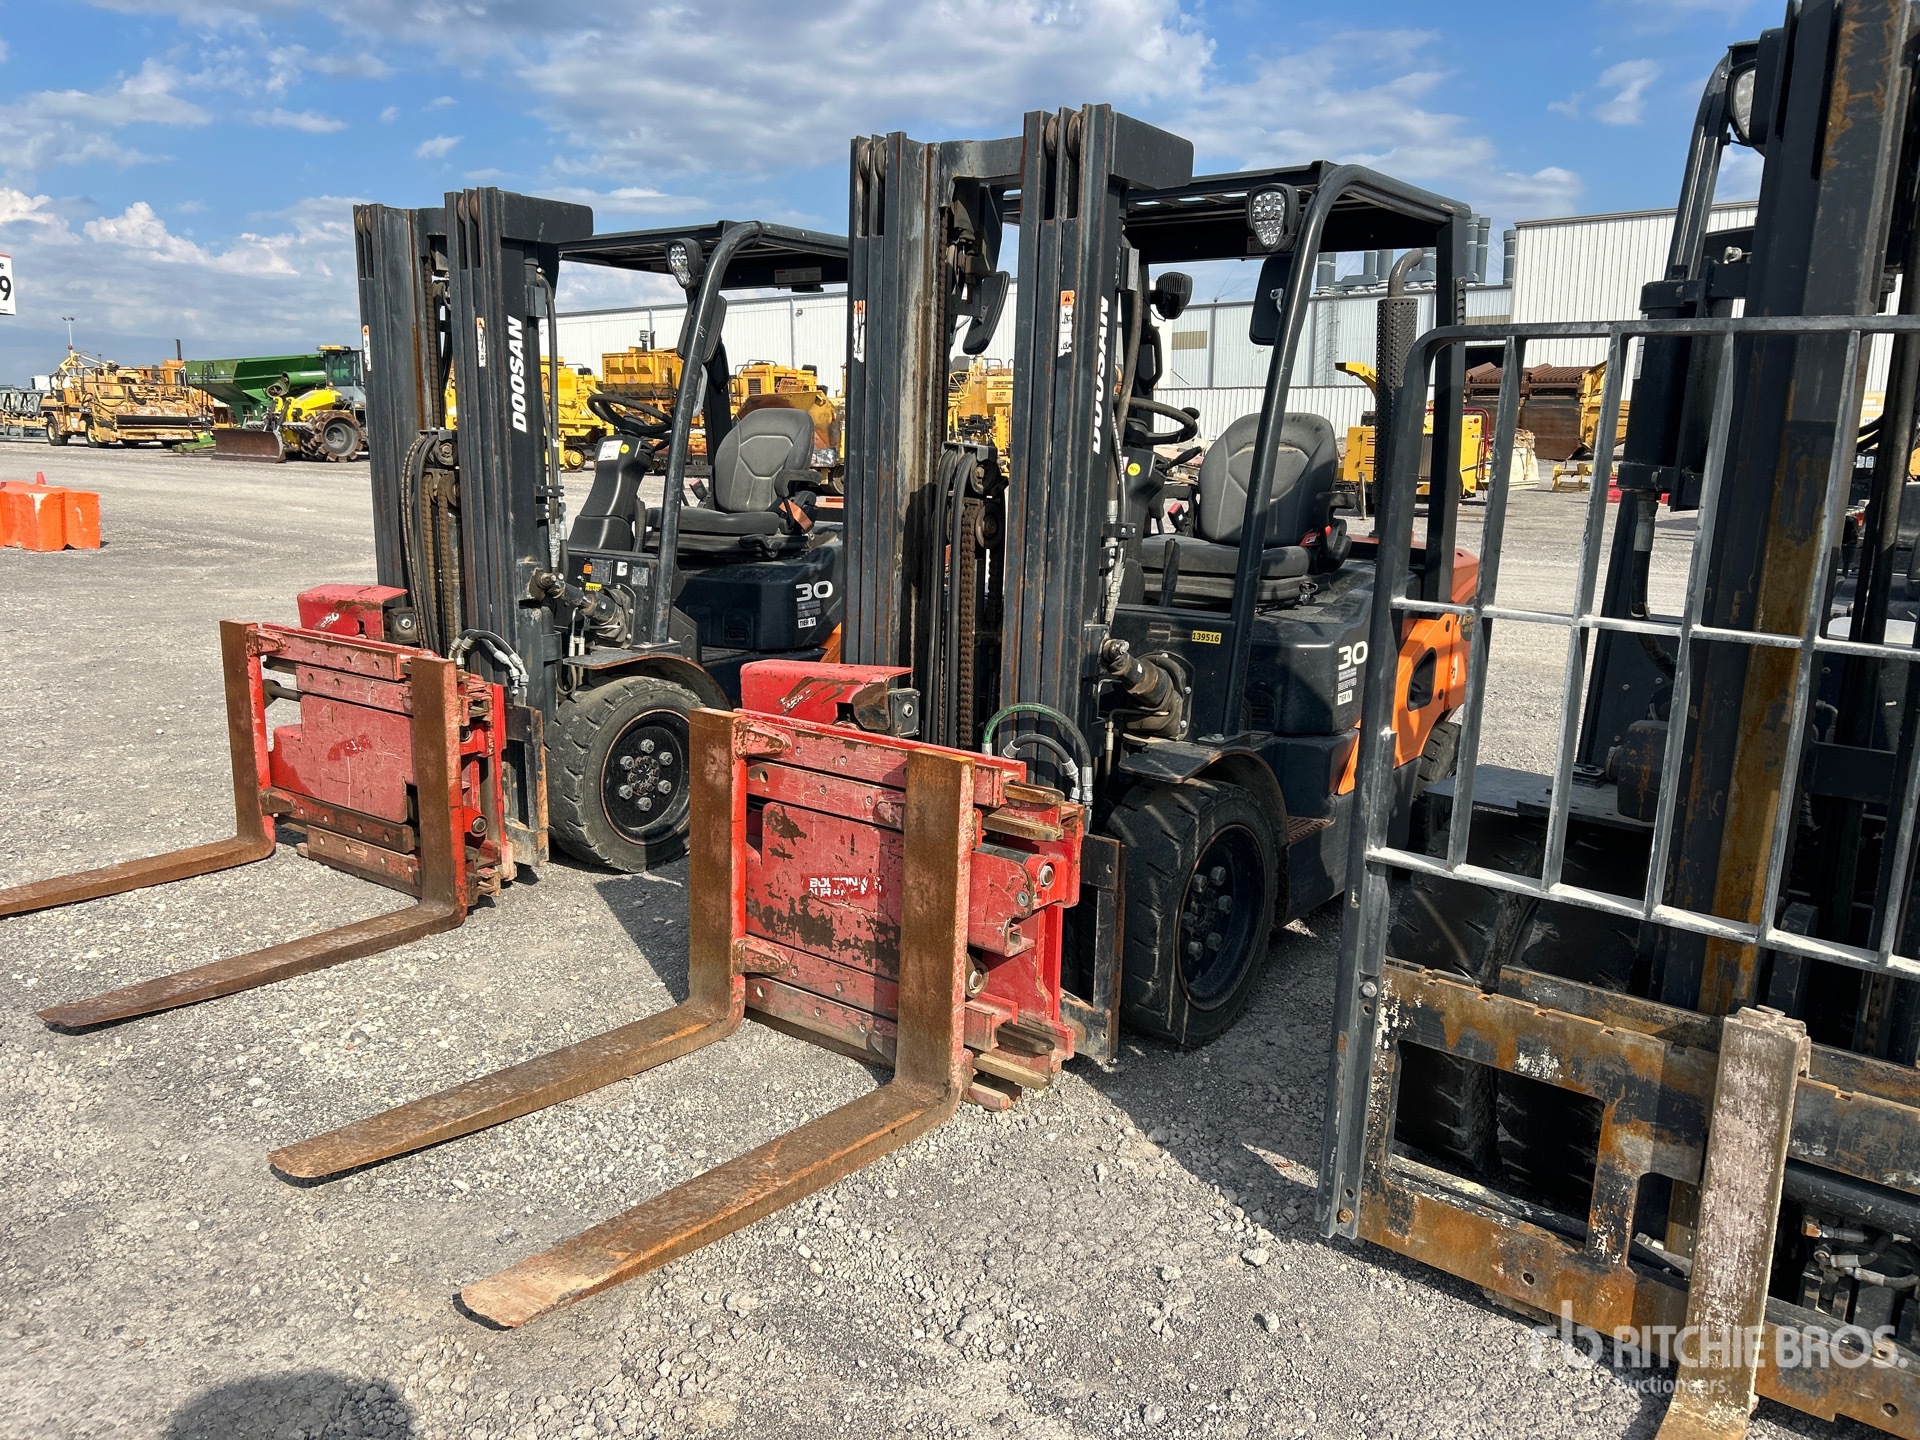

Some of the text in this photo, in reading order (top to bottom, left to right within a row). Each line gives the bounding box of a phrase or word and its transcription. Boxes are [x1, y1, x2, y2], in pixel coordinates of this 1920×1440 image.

[507, 314, 527, 434] DOOSAN
[795, 580, 834, 602] 30
[1192, 632, 1220, 642] 139516
[1338, 640, 1369, 671] 30
